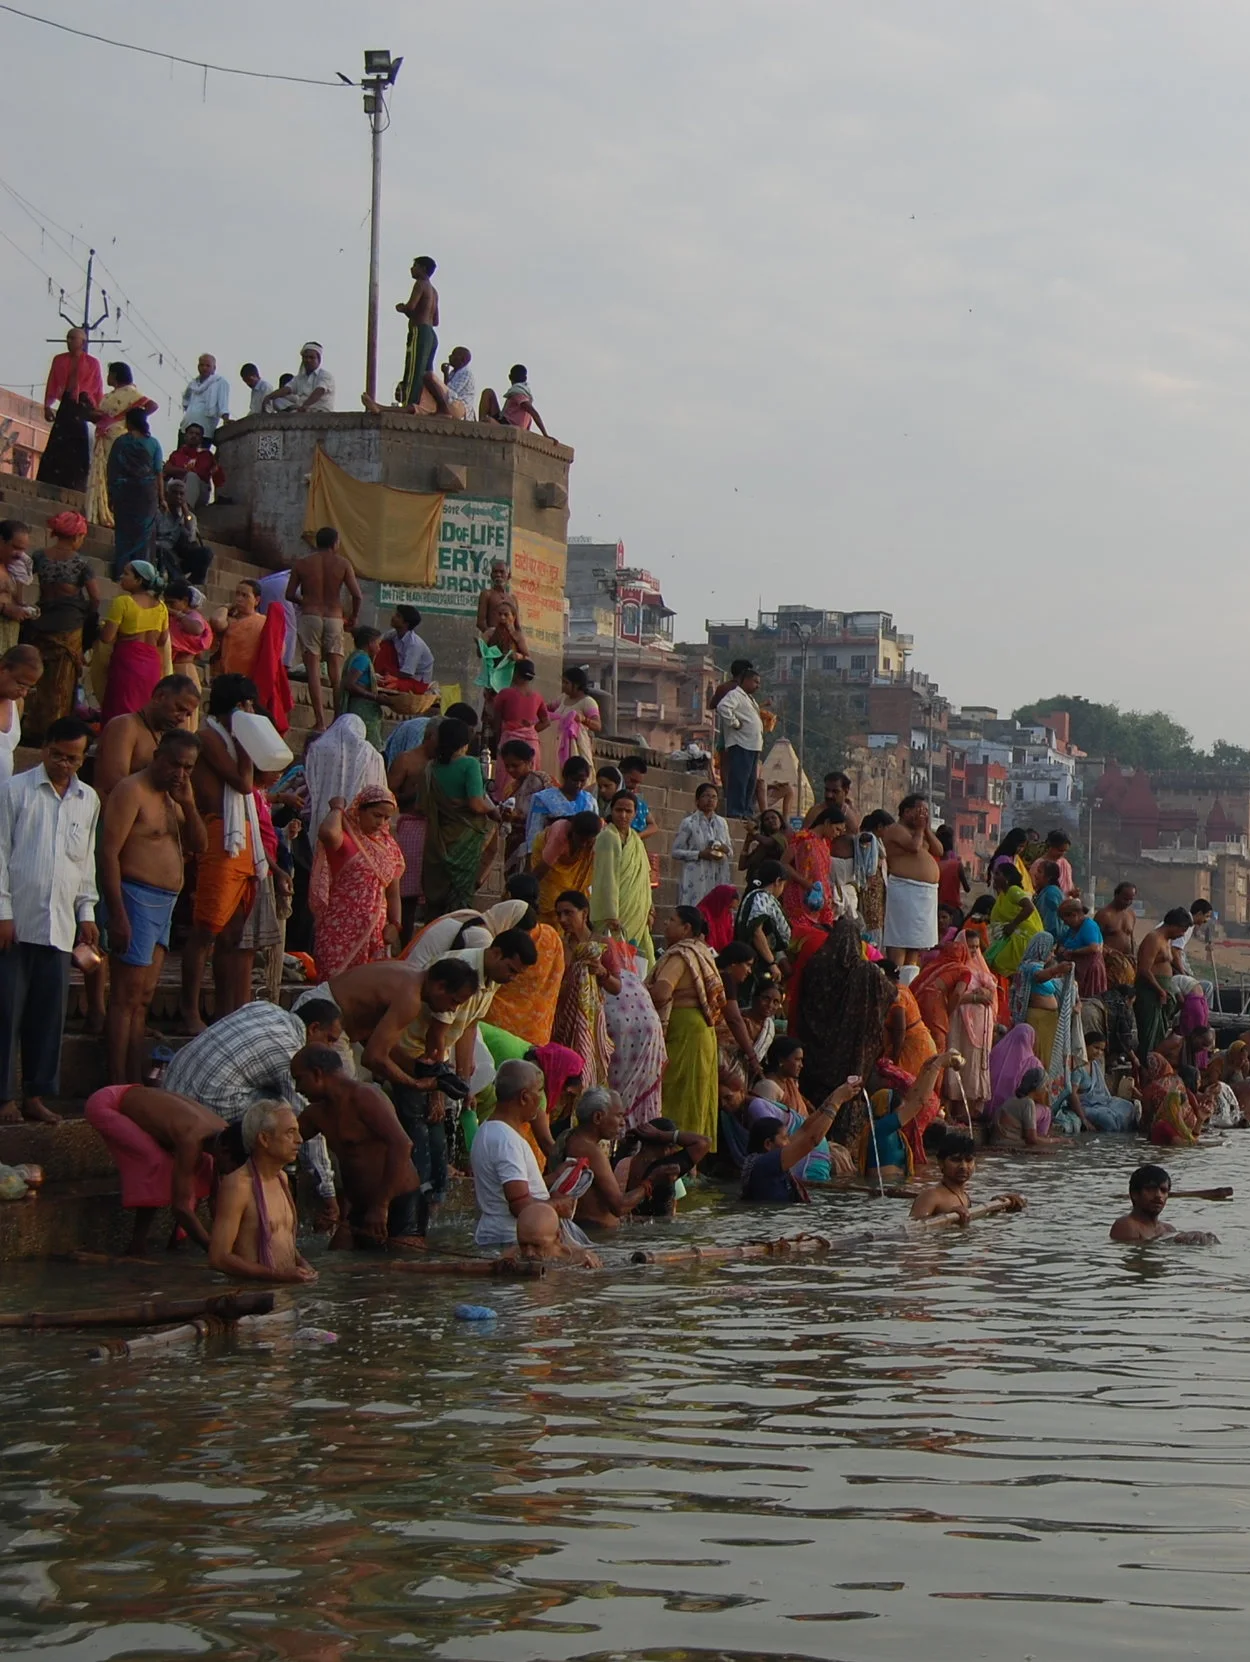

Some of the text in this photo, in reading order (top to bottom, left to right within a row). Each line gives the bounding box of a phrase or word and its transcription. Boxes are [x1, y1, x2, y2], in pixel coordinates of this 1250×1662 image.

[438, 522, 504, 547] D OF LIFE
